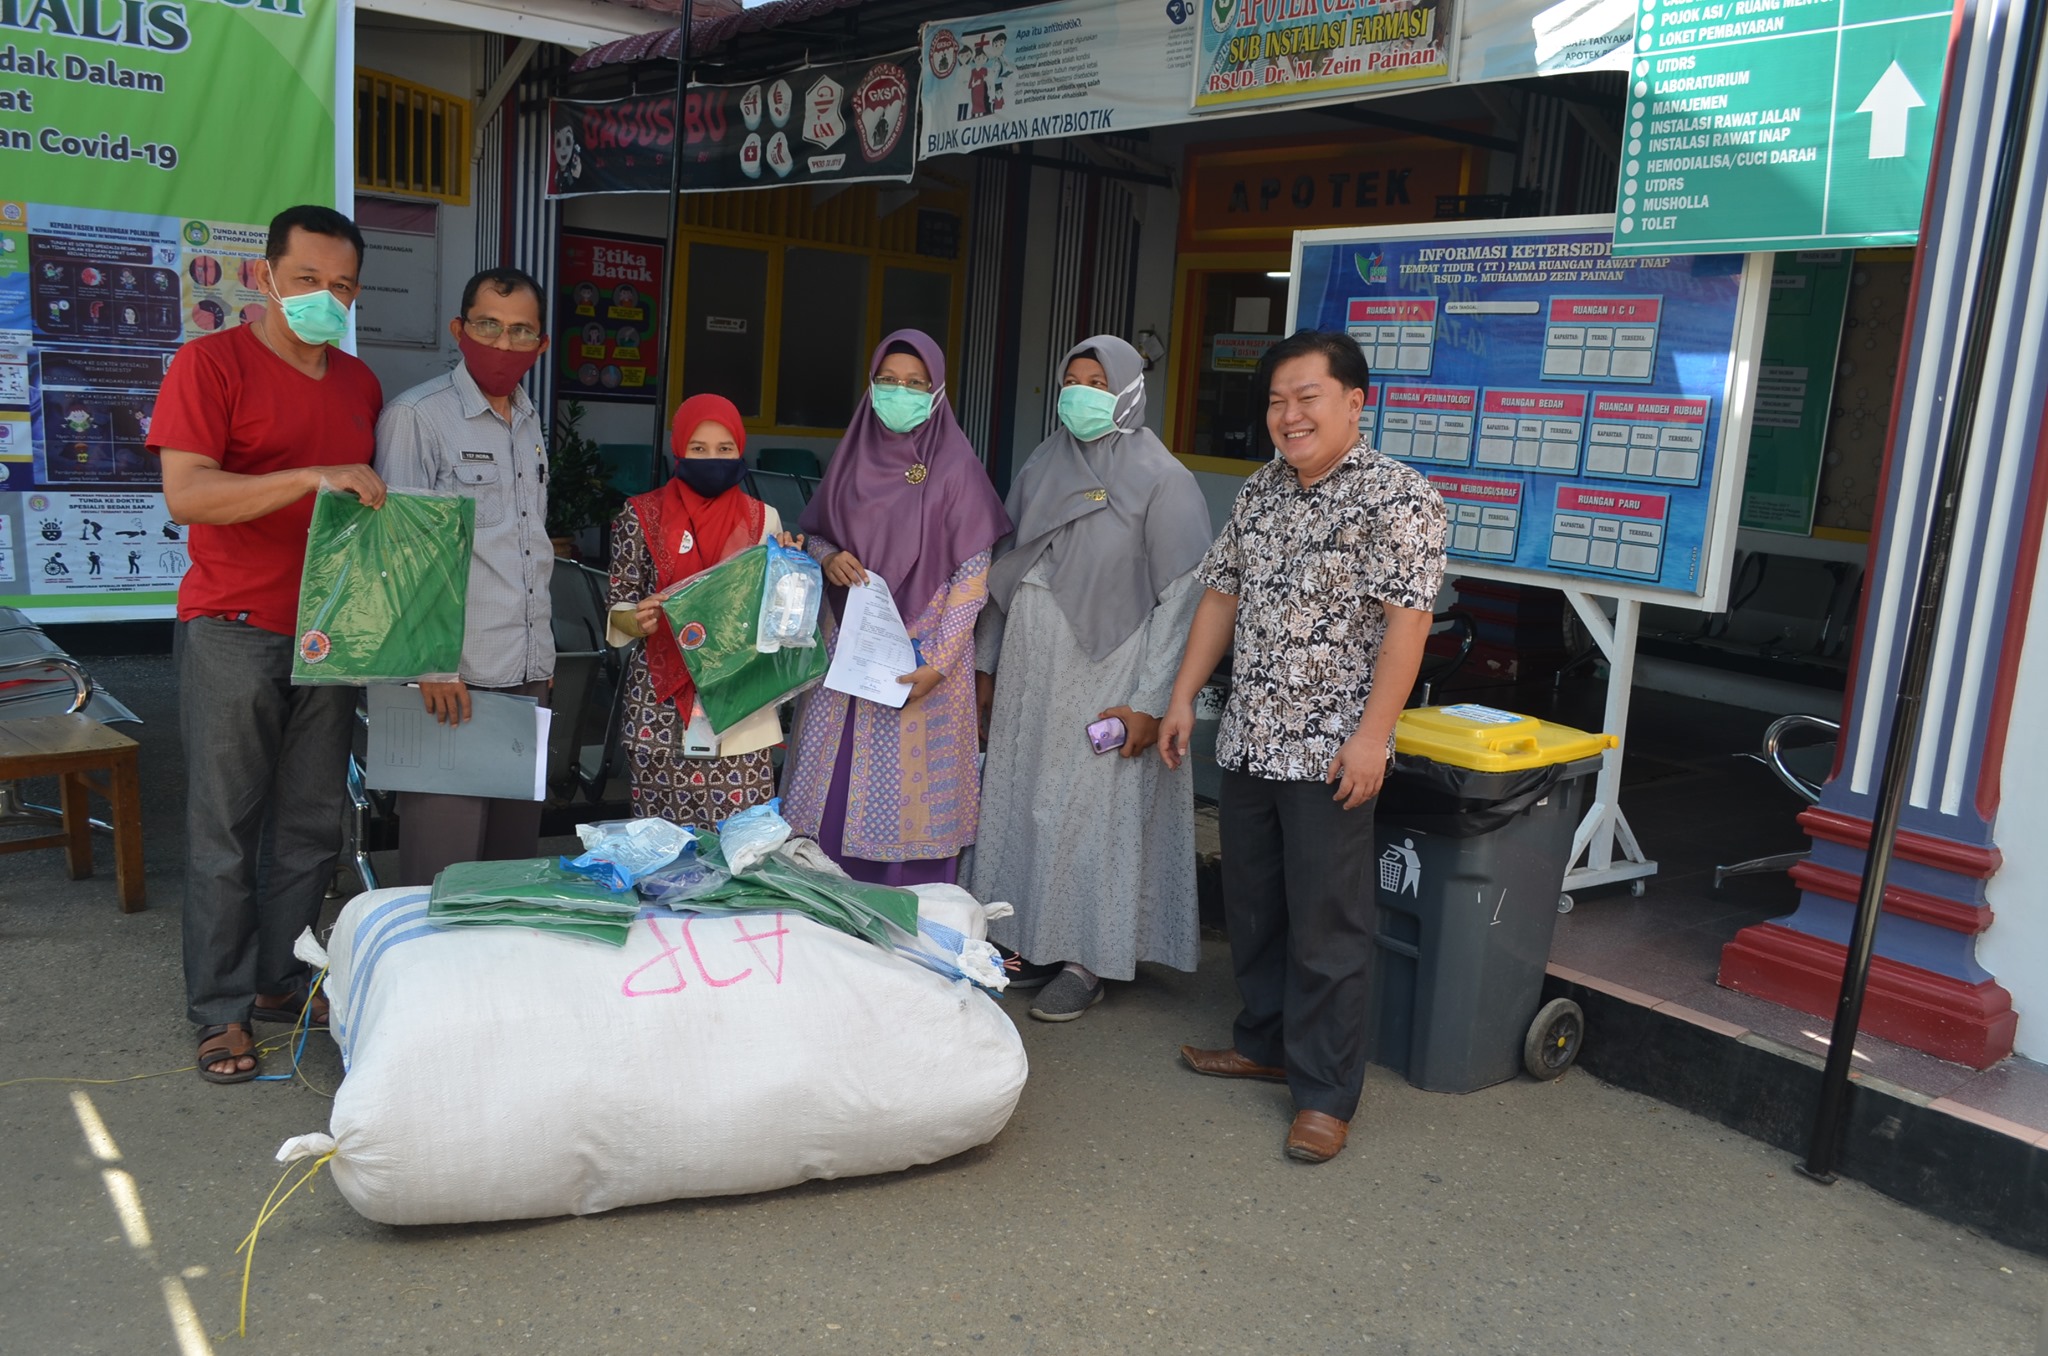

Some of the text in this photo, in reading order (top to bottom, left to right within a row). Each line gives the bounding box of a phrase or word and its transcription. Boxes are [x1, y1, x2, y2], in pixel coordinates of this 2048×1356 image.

[1661, 10, 1700, 27] POJOK
[1702, 8, 1723, 21] ASI
[1016, 18, 1082, 40] Apa itu antibiotik?
[1229, 34, 1261, 64] SUB
[1265, 20, 1347, 58] INSTALASI
[1350, 7, 1430, 46] FARMASI
[1659, 16, 1784, 47] LOKET PEMBAYARAN
[1565, 50, 1600, 61] APOTEK
[1656, 55, 1696, 73] UTDRS
[64, 55, 163, 92] Dalam
[1210, 48, 1435, 91] RSUD. Dr. M. Zein Painan
[1654, 70, 1750, 94] LABORATURIUM
[1652, 94, 1728, 115] MANAJEMEN
[582, 89, 729, 150] DAGUSBU
[1650, 107, 1800, 135] INSTALASI RAWAT JALAN
[928, 108, 1115, 152] BIJAK GUNAKAN ANTIBIOTIK
[1649, 127, 1791, 152] INSTALASI RAWAT INAP
[39, 127, 178, 169] Covid-19
[1647, 147, 1816, 173] HEMODIALISA/CUCI DARAH
[1228, 167, 1413, 213] APOTEK
[1645, 177, 1684, 192] UTDRS
[1643, 194, 1709, 212] MUSHOLLA
[1641, 216, 1677, 231] TOLET
[212, 235, 258, 244] ORTHOPAEDI
[592, 246, 647, 266] Etika
[1418, 245, 1508, 262] INFORMASI
[592, 261, 652, 282] Batuk
[1399, 264, 1440, 273] TEMPAT
[1442, 263, 1474, 272] TIDUR
[1507, 261, 1536, 271] PADA
[1538, 259, 1594, 270] RUANGAN
[1596, 258, 1637, 269] RAWAT
[1640, 257, 1670, 268] INAP
[1433, 271, 1624, 284] RSUD Dr. MUHAMMAD ZEIN PAINAN
[1366, 306, 1396, 314] RUANGAN
[1573, 306, 1608, 314] RUANGAN
[1390, 392, 1471, 404] RUANGAN PERINATOLOGI
[1501, 398, 1564, 408] RUANGAN BEDAH
[1599, 401, 1703, 415] RUANGAN MANDEH RUBIAH
[1460, 484, 1517, 497] NEUROLOGI/SARAF
[1578, 494, 1641, 509] RUANGAN PARU
